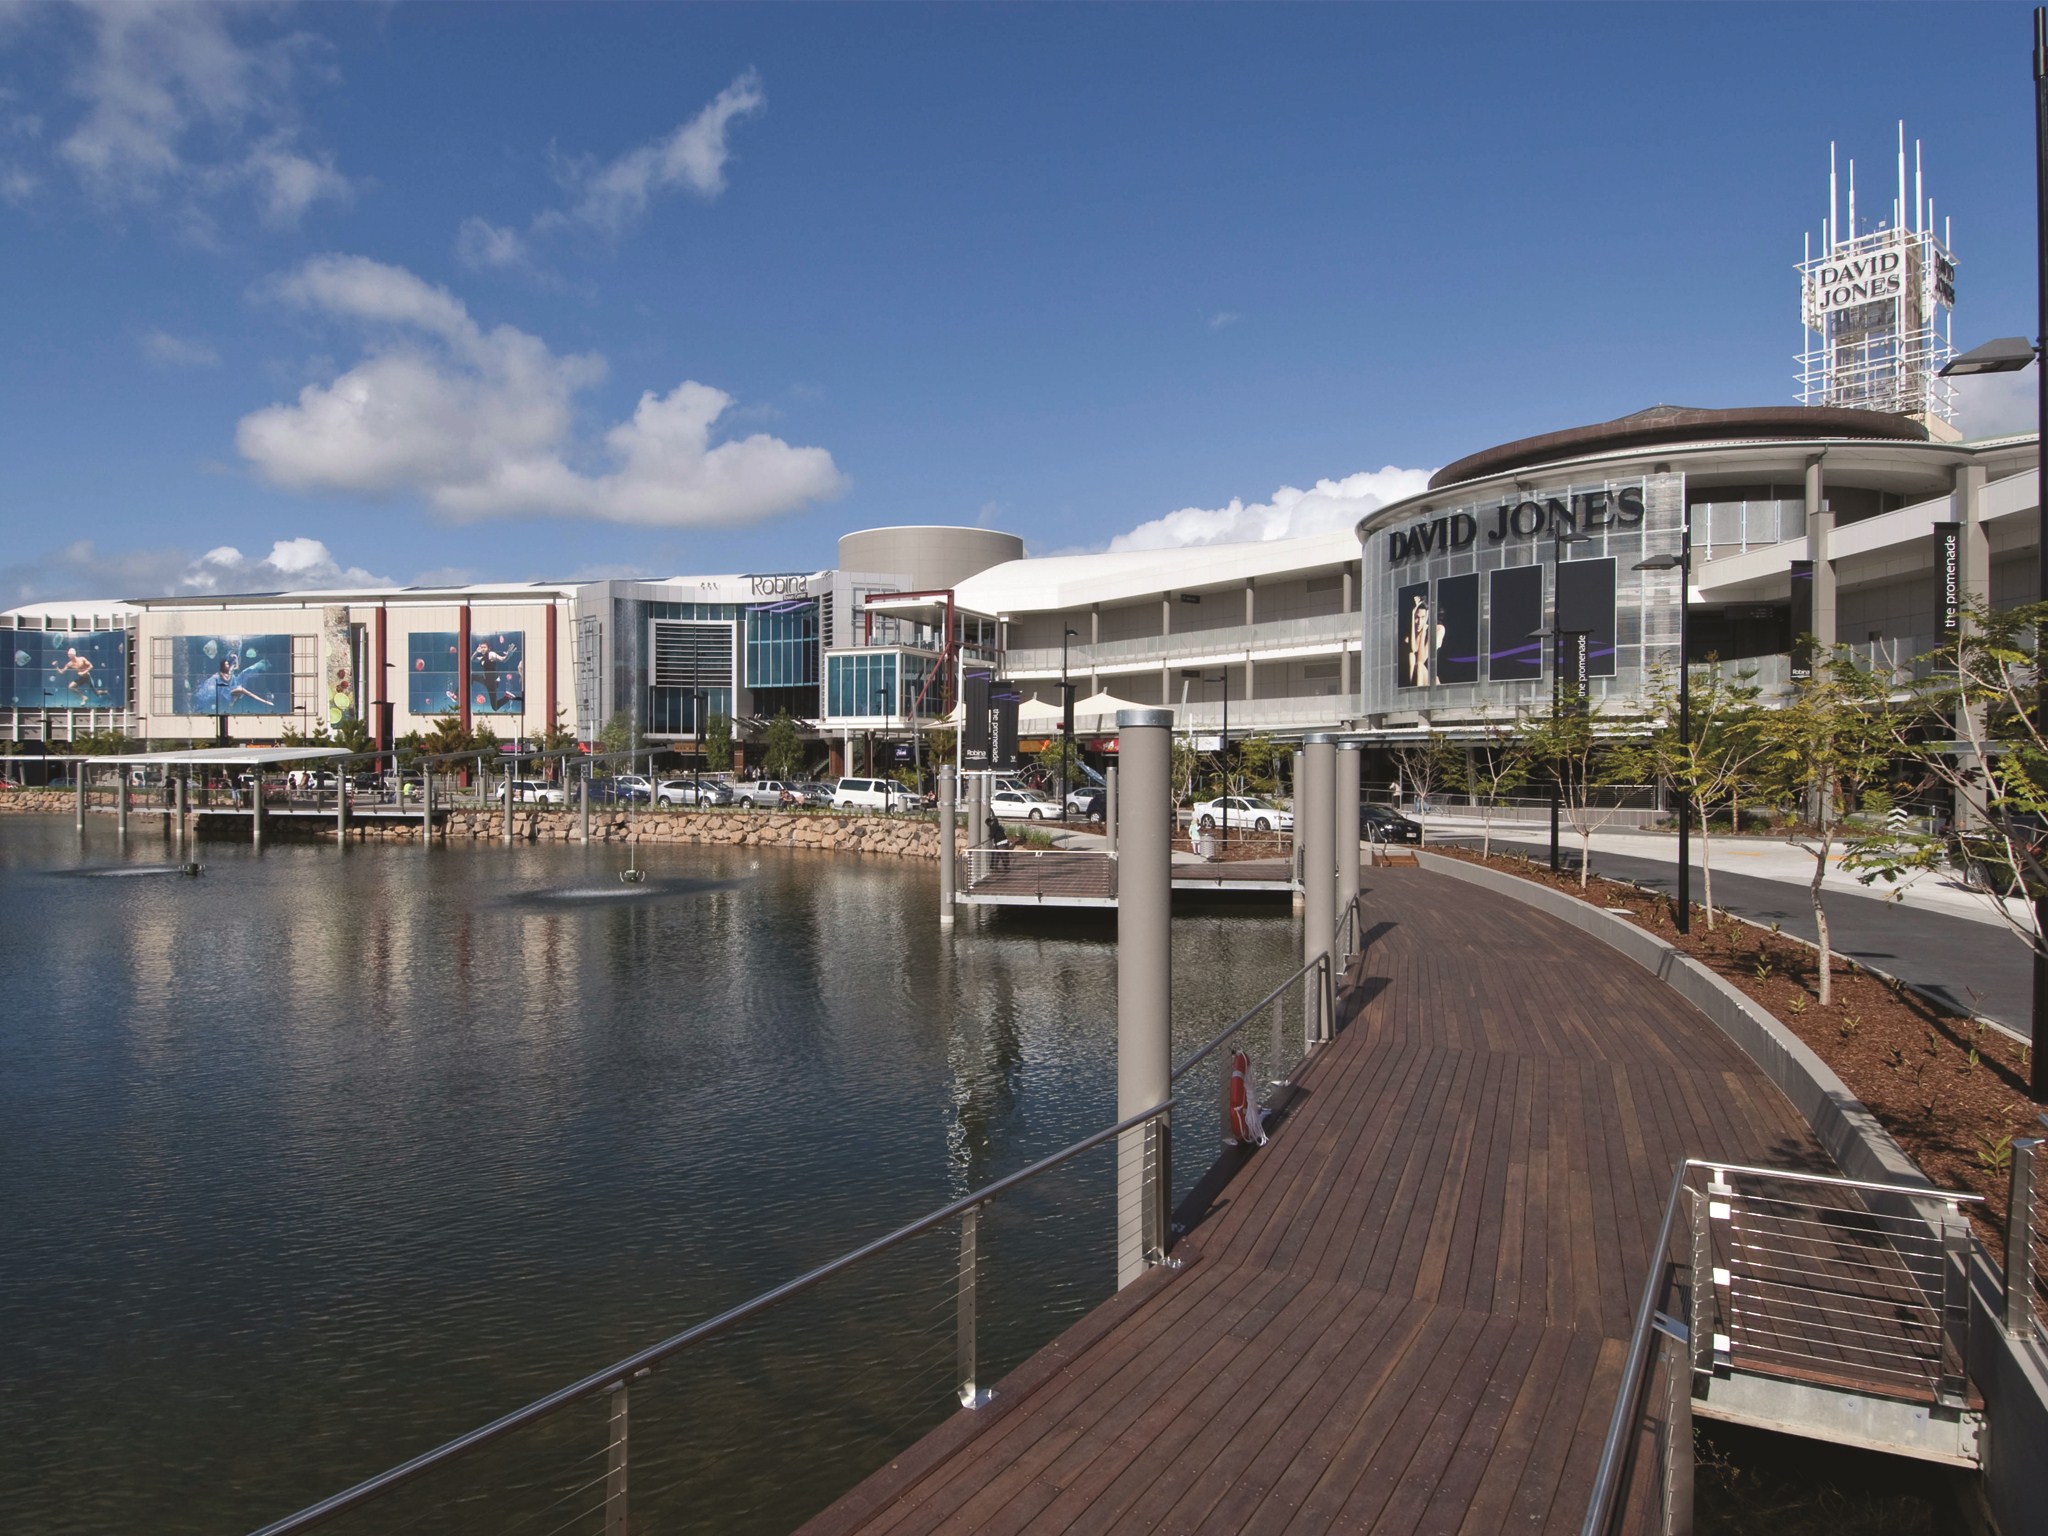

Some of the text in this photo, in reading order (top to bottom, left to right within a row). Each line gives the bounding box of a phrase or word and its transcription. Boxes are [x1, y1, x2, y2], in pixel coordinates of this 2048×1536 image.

[1819, 273, 1900, 311] JONES
[1820, 252, 1899, 288] DAVID
[1388, 486, 1645, 563] DAVID JONES
[751, 575, 808, 596] Robina
[1944, 534, 1958, 628] the promenade
[1577, 634, 1588, 697] the promenade
[966, 749, 987, 757] Robina
[991, 708, 1000, 763] the promenade
